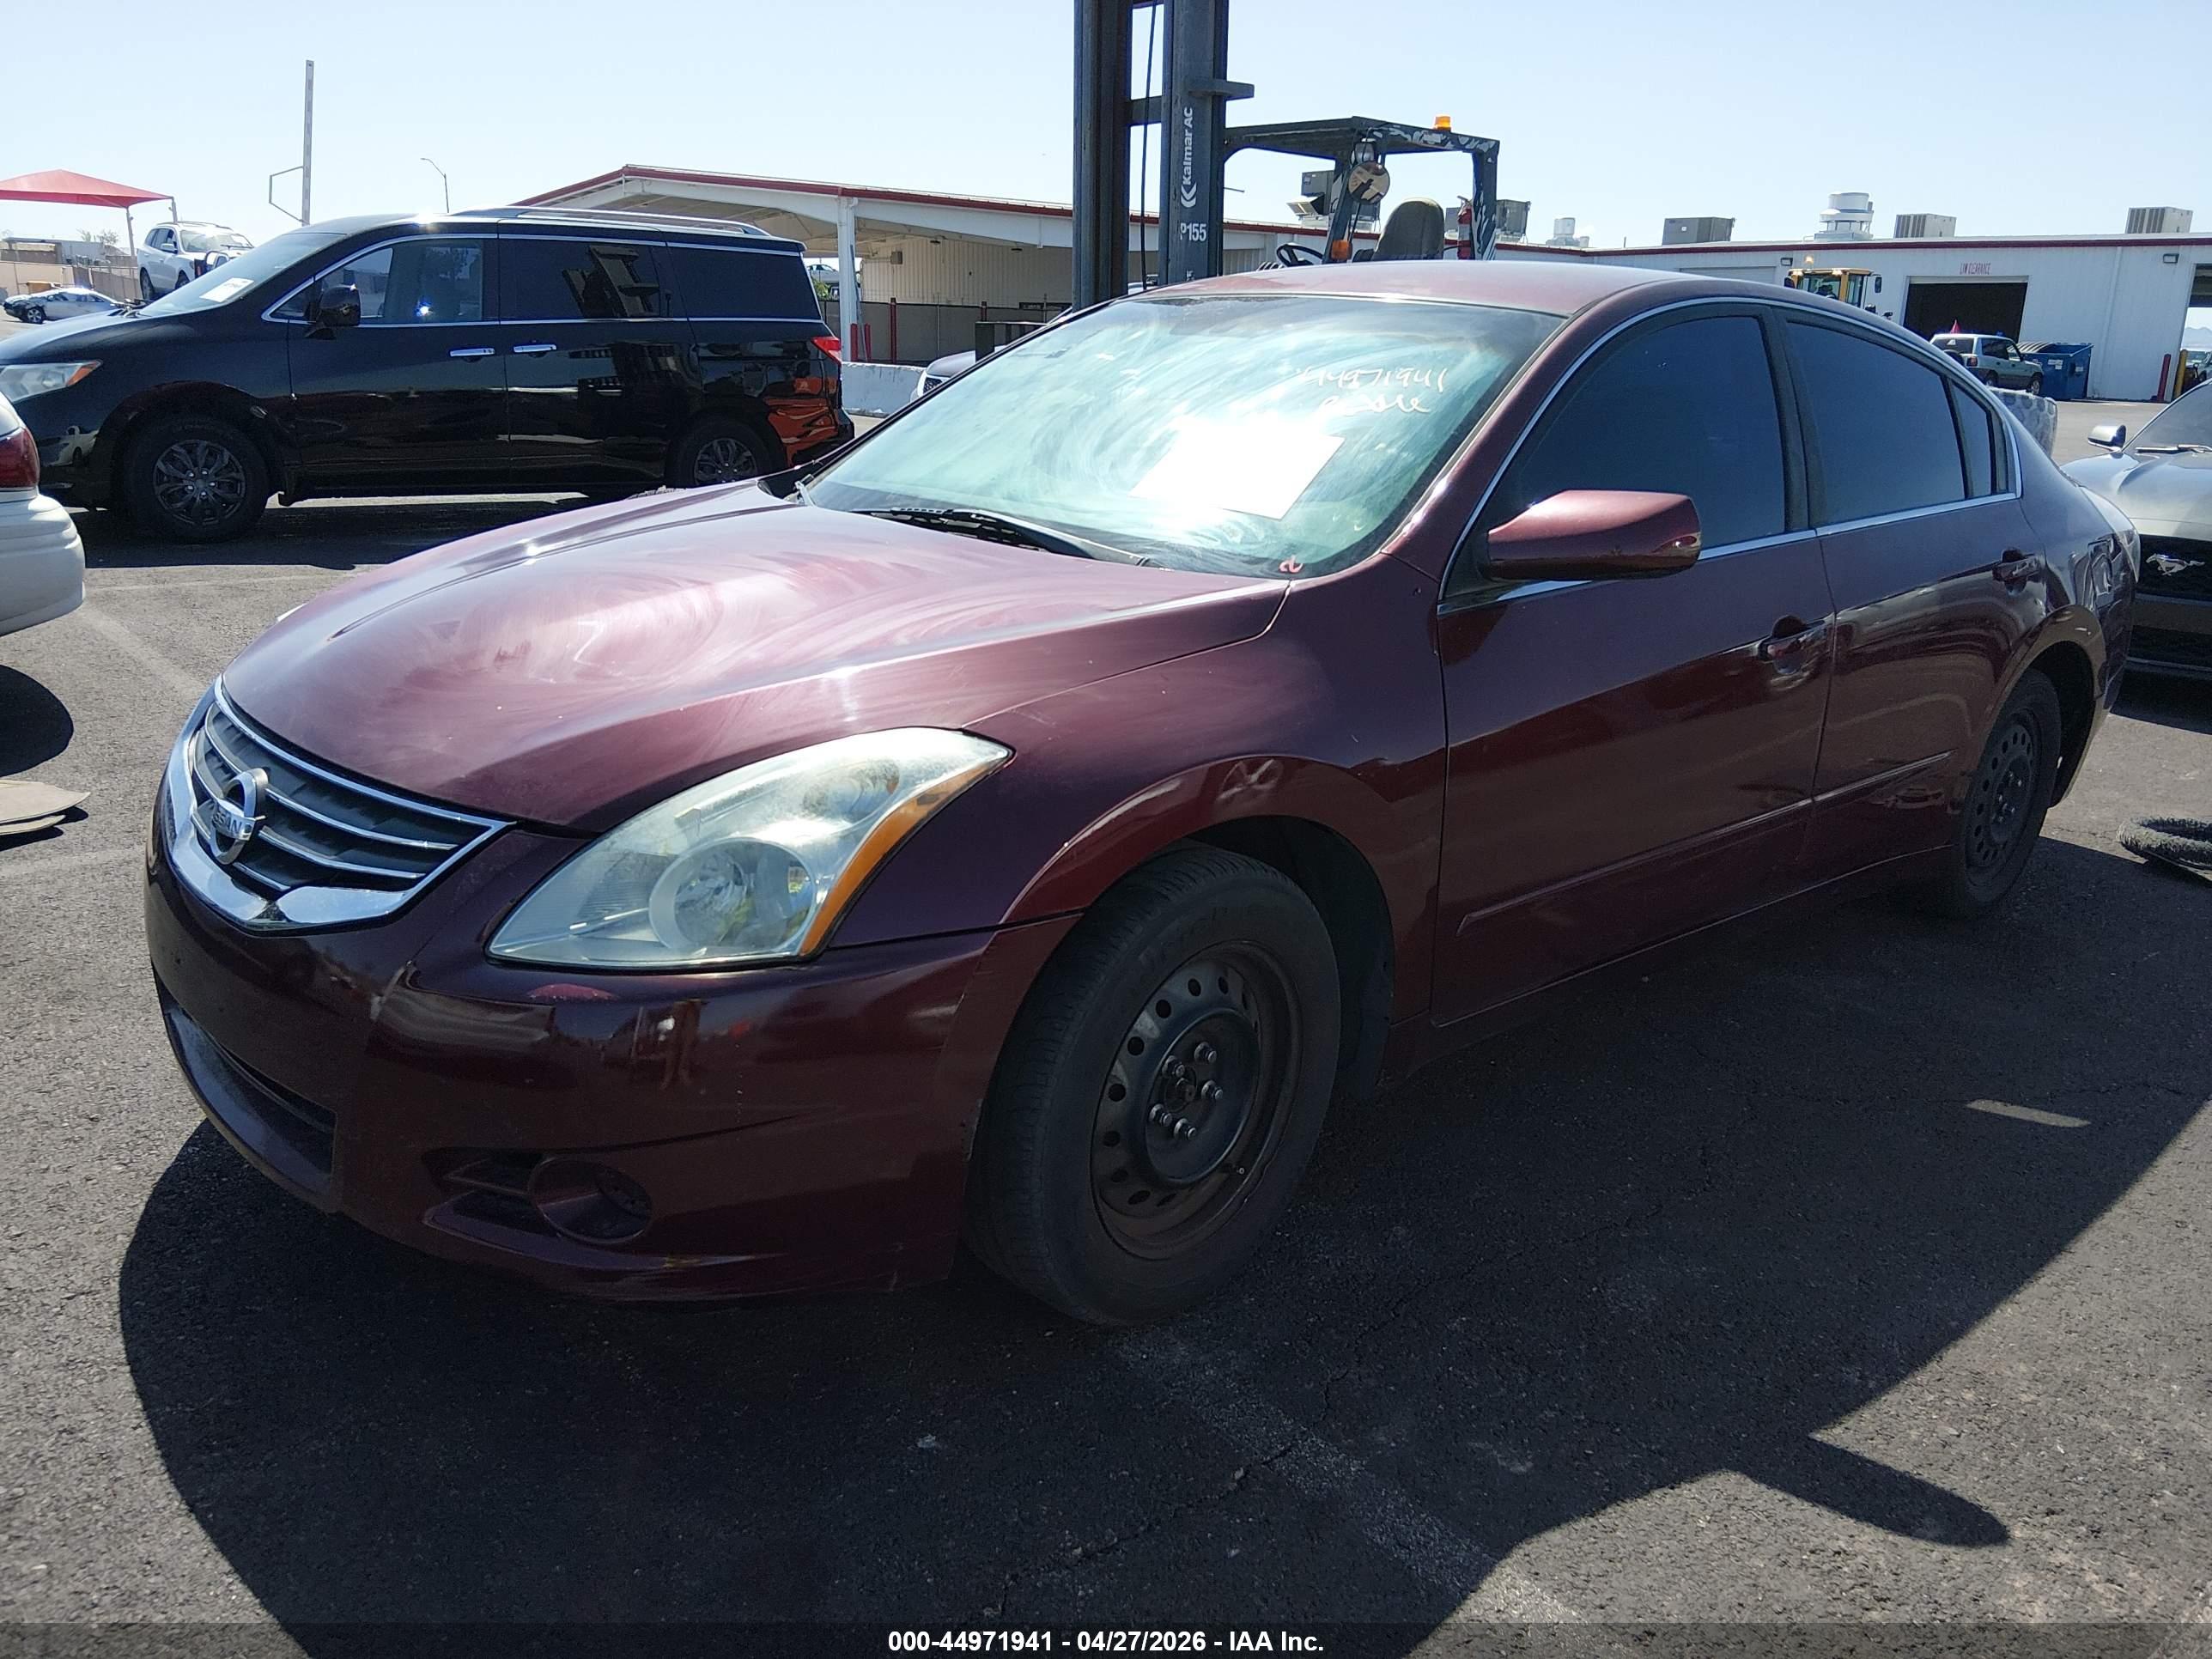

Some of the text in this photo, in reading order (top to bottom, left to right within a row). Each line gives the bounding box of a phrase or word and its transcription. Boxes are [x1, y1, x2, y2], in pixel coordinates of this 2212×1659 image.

[1183, 106, 1193, 185] Kalmar AC
[1180, 223, 1206, 241] P155
